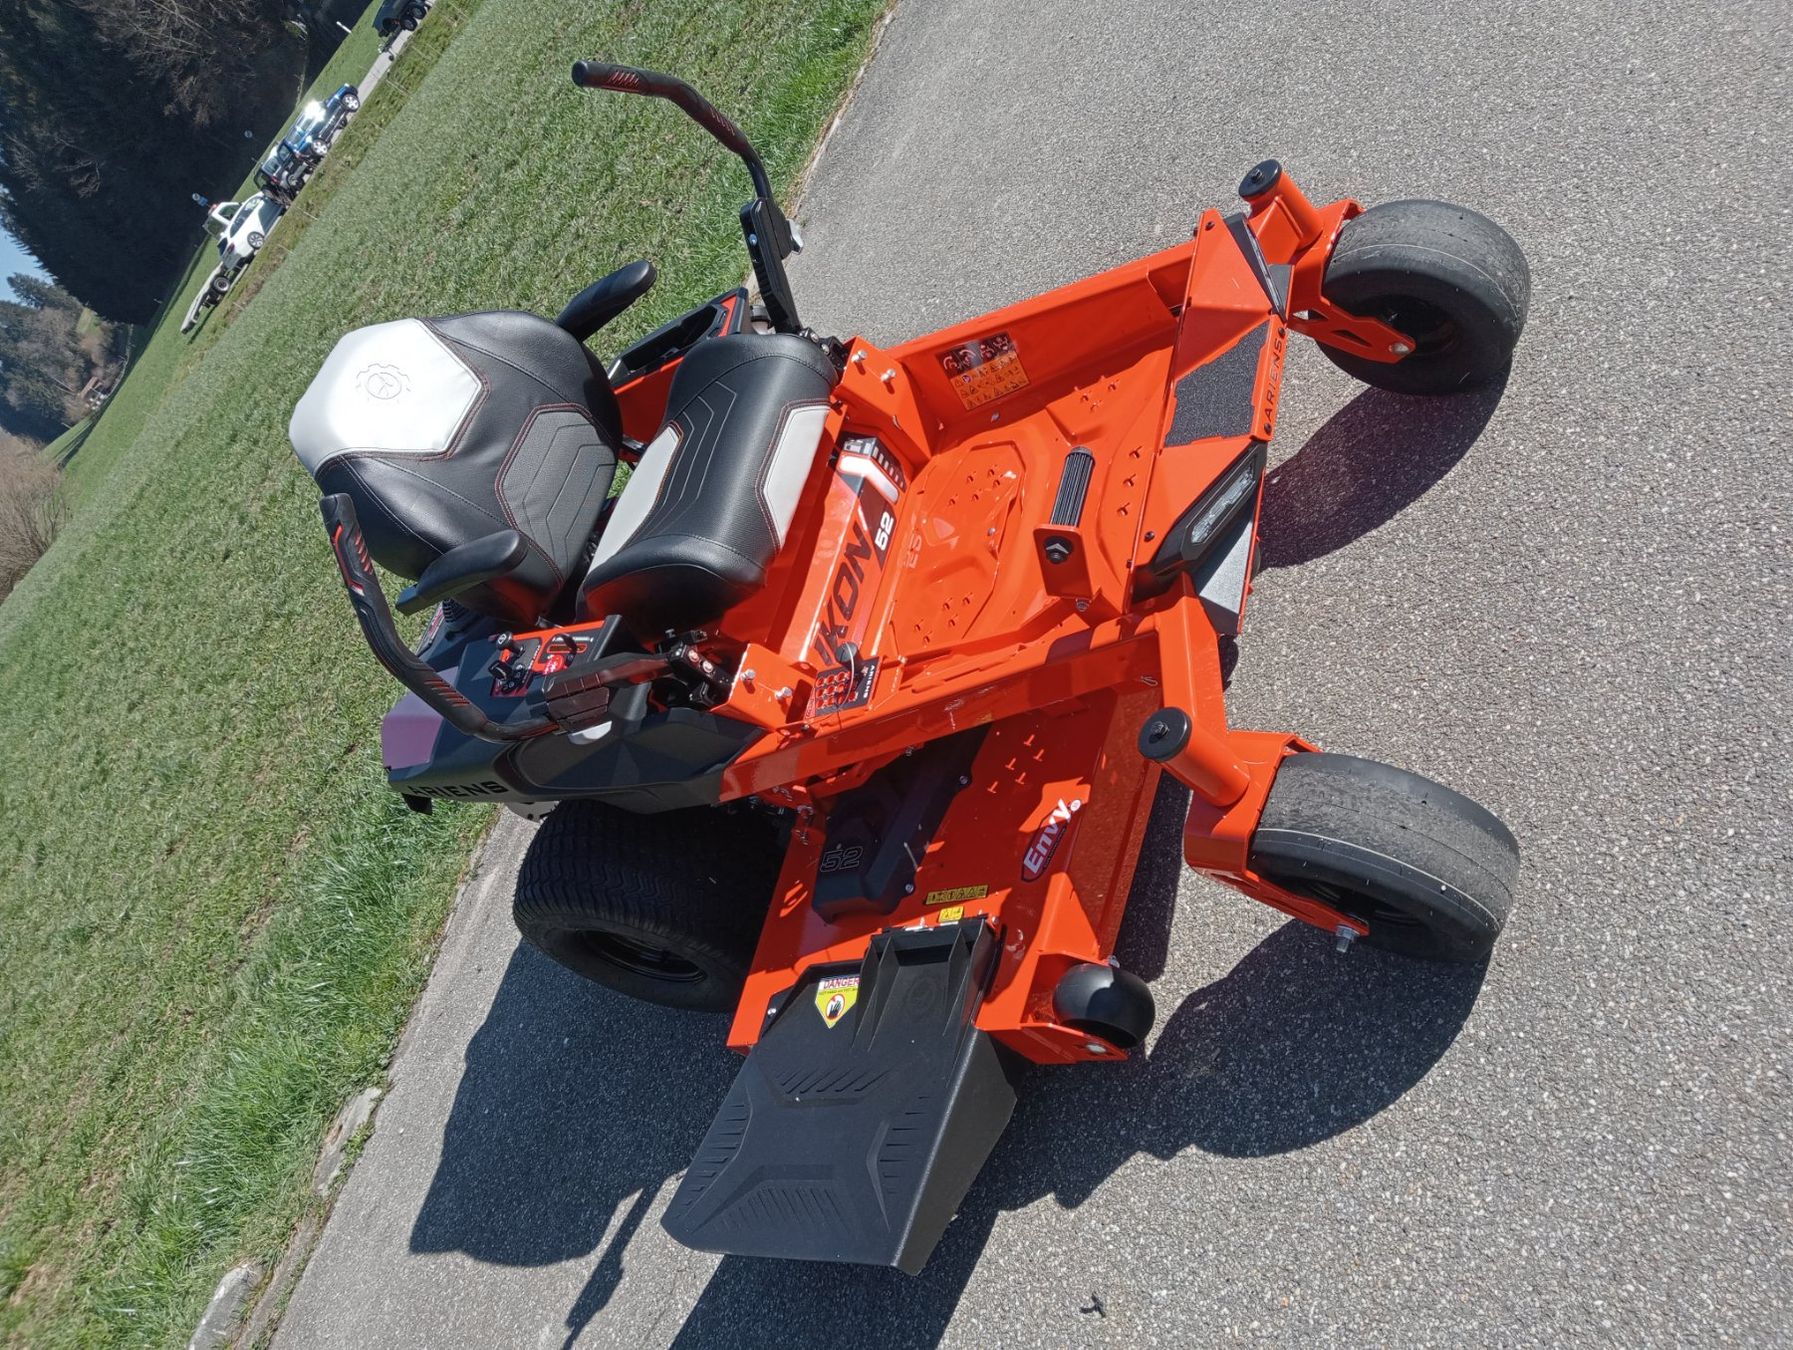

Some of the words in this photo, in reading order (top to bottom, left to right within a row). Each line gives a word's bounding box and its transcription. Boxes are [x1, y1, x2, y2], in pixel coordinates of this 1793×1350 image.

[1263, 338, 1283, 422] ARIENS
[814, 521, 872, 665] IKON
[875, 511, 894, 551] 52
[819, 845, 864, 873] 52
[1023, 799, 1071, 875] Envy
[823, 976, 861, 989] DANGER
